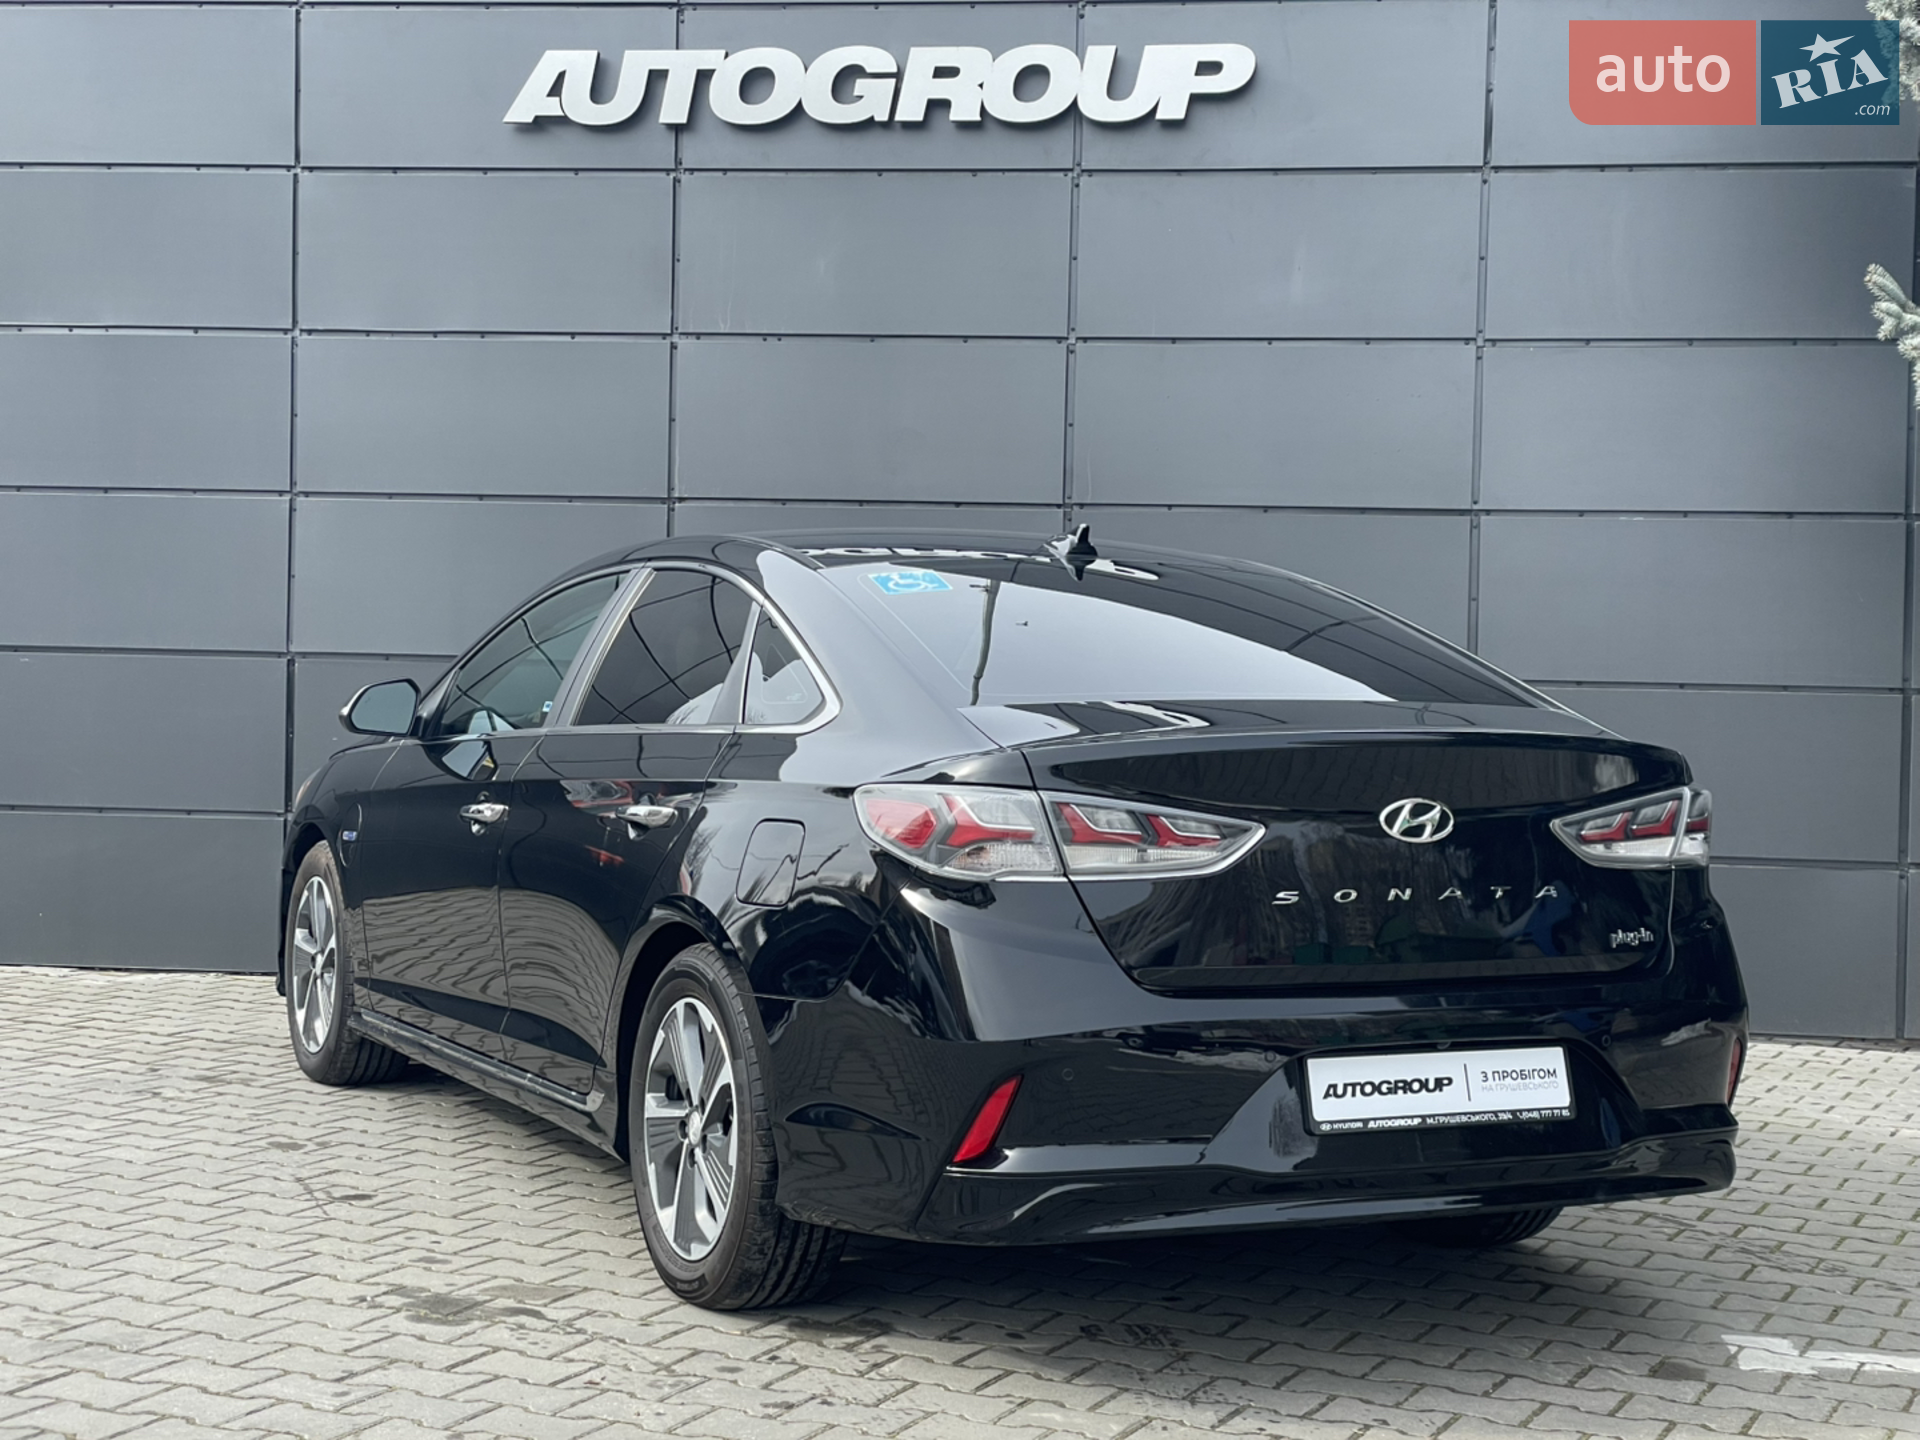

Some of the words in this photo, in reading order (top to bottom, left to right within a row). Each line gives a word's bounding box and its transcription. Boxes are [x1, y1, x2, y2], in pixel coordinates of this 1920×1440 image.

[503, 44, 1257, 125] AUTOGROUP
[1272, 885, 1560, 906] SONATA
[1491, 1067, 1558, 1082] ПРОБІГОМ
[1322, 1076, 1454, 1100] AUTOGROUP
[1481, 1082, 1495, 1093] НА
[1494, 1080, 1560, 1093] ГРУШЕВСЬКОГО
[1332, 1121, 1364, 1130] HYUNDAI
[1367, 1117, 1423, 1129] AUTOGROUP
